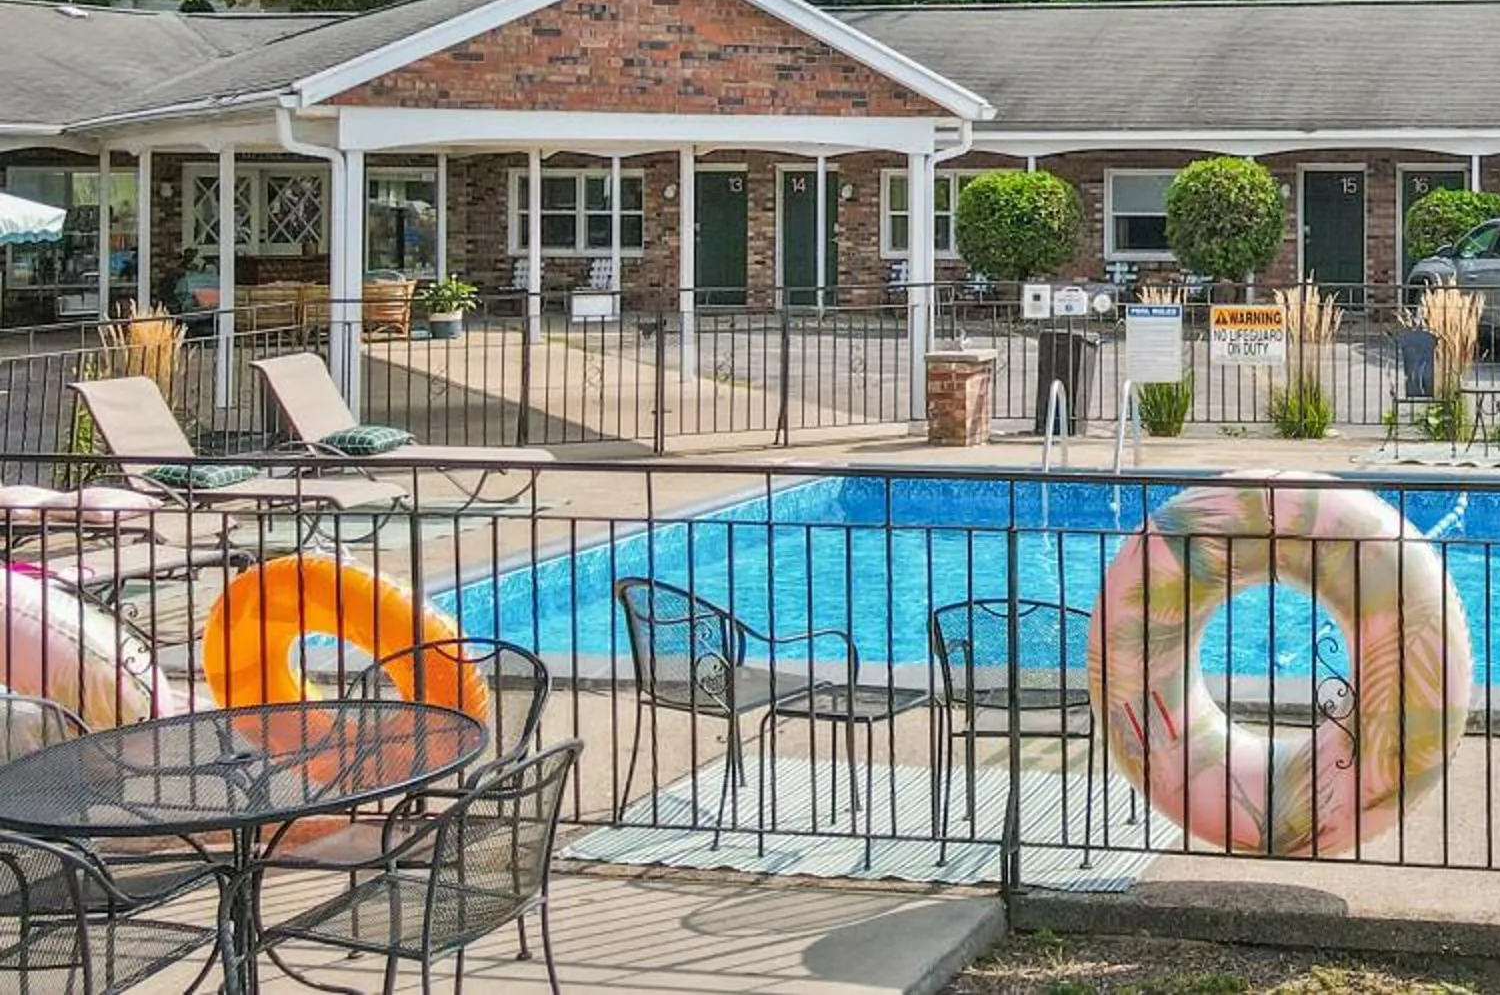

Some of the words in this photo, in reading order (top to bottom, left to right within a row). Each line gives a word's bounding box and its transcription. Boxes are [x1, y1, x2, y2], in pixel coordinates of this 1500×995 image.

[728, 178, 743, 192] 13
[792, 177, 805, 193] 14
[1341, 177, 1357, 194] 15
[1413, 177, 1429, 194] 16
[1229, 311, 1282, 325] WARNING
[1213, 328, 1227, 342] NO
[1229, 328, 1283, 342] LIFEGUARD
[1227, 342, 1241, 356] ON
[1243, 342, 1269, 356] DUTY
